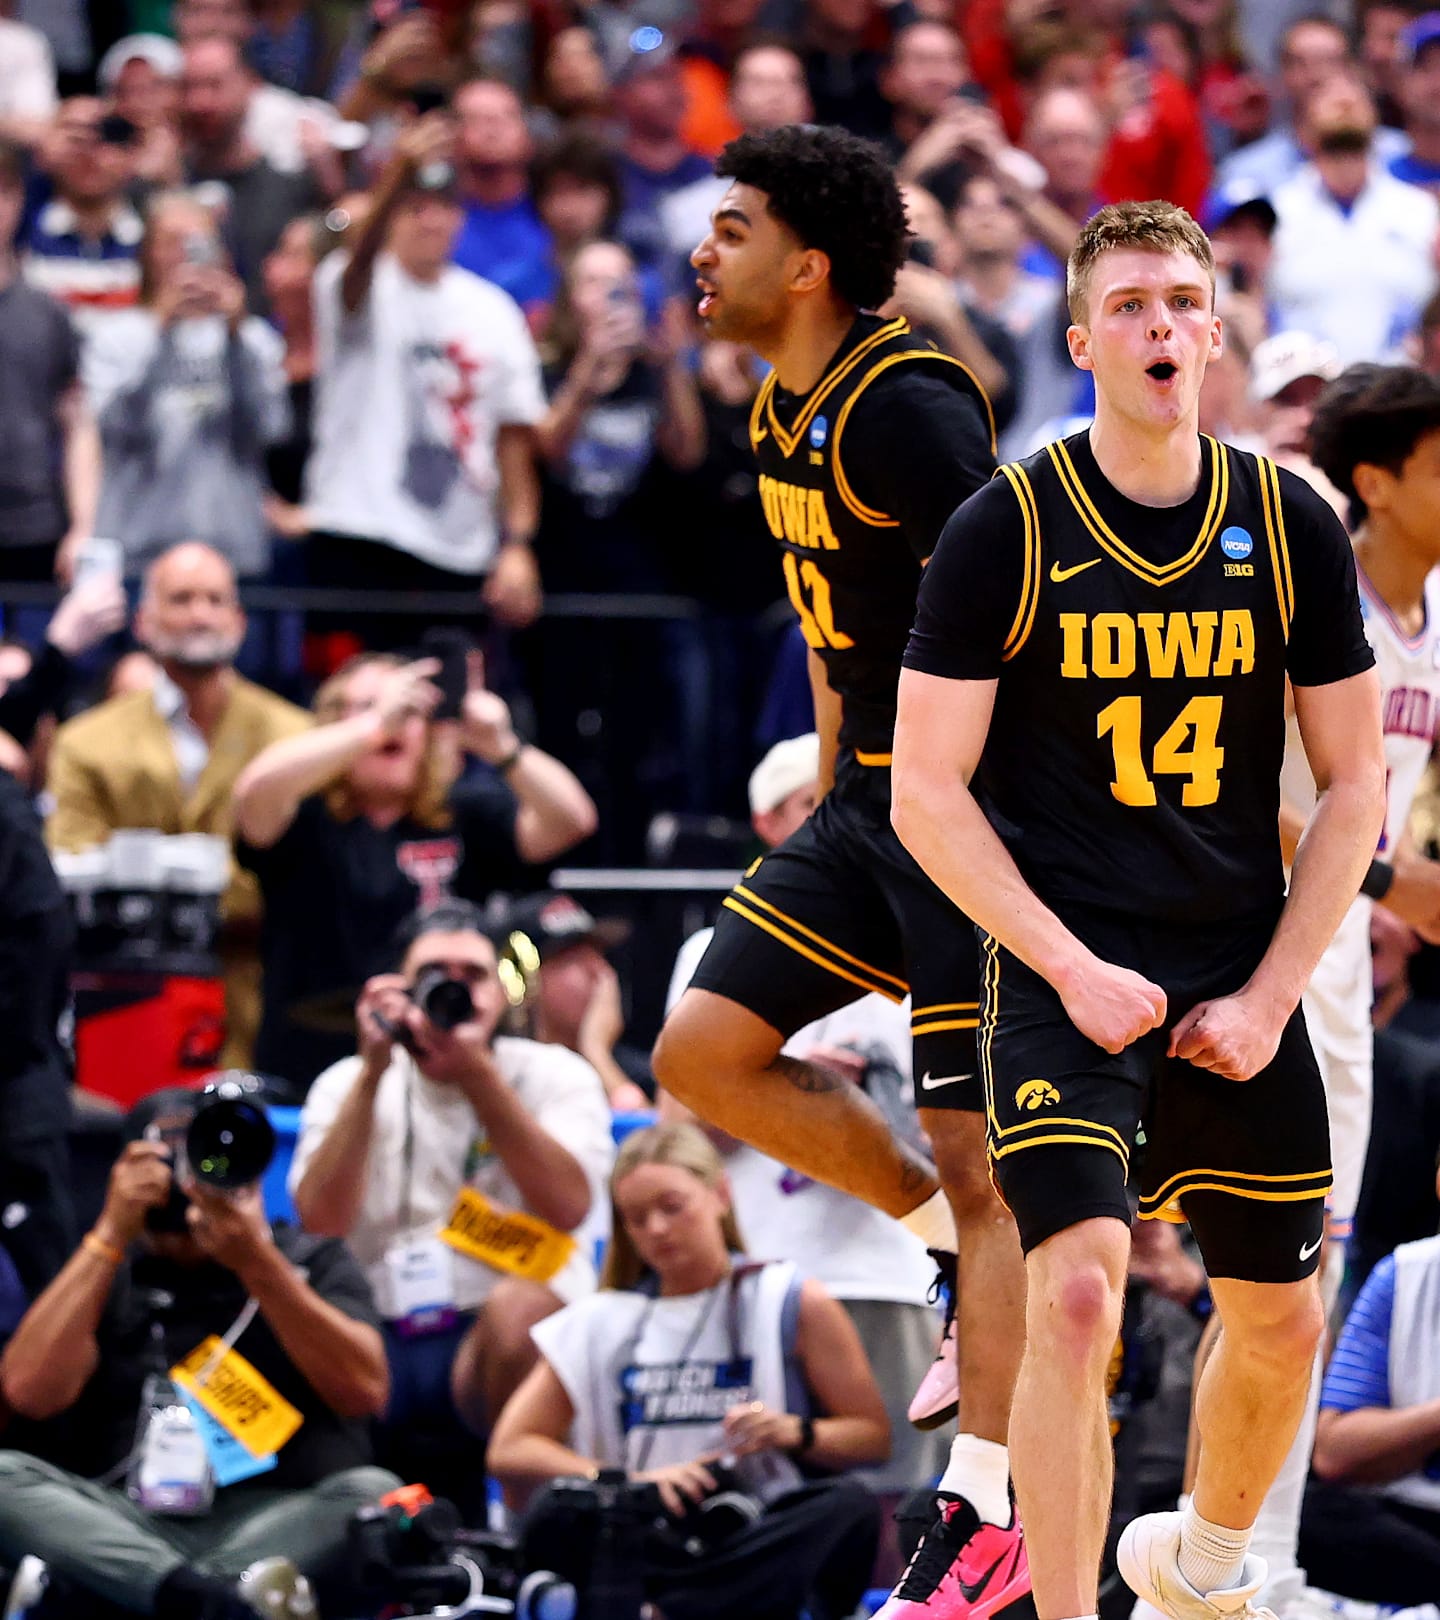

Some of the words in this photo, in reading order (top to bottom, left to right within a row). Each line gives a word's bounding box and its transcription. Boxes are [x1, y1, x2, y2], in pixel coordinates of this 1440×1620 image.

[1224, 540, 1251, 553] NCAA
[1059, 609, 1255, 679] IOWA
[1096, 695, 1225, 807] 14
